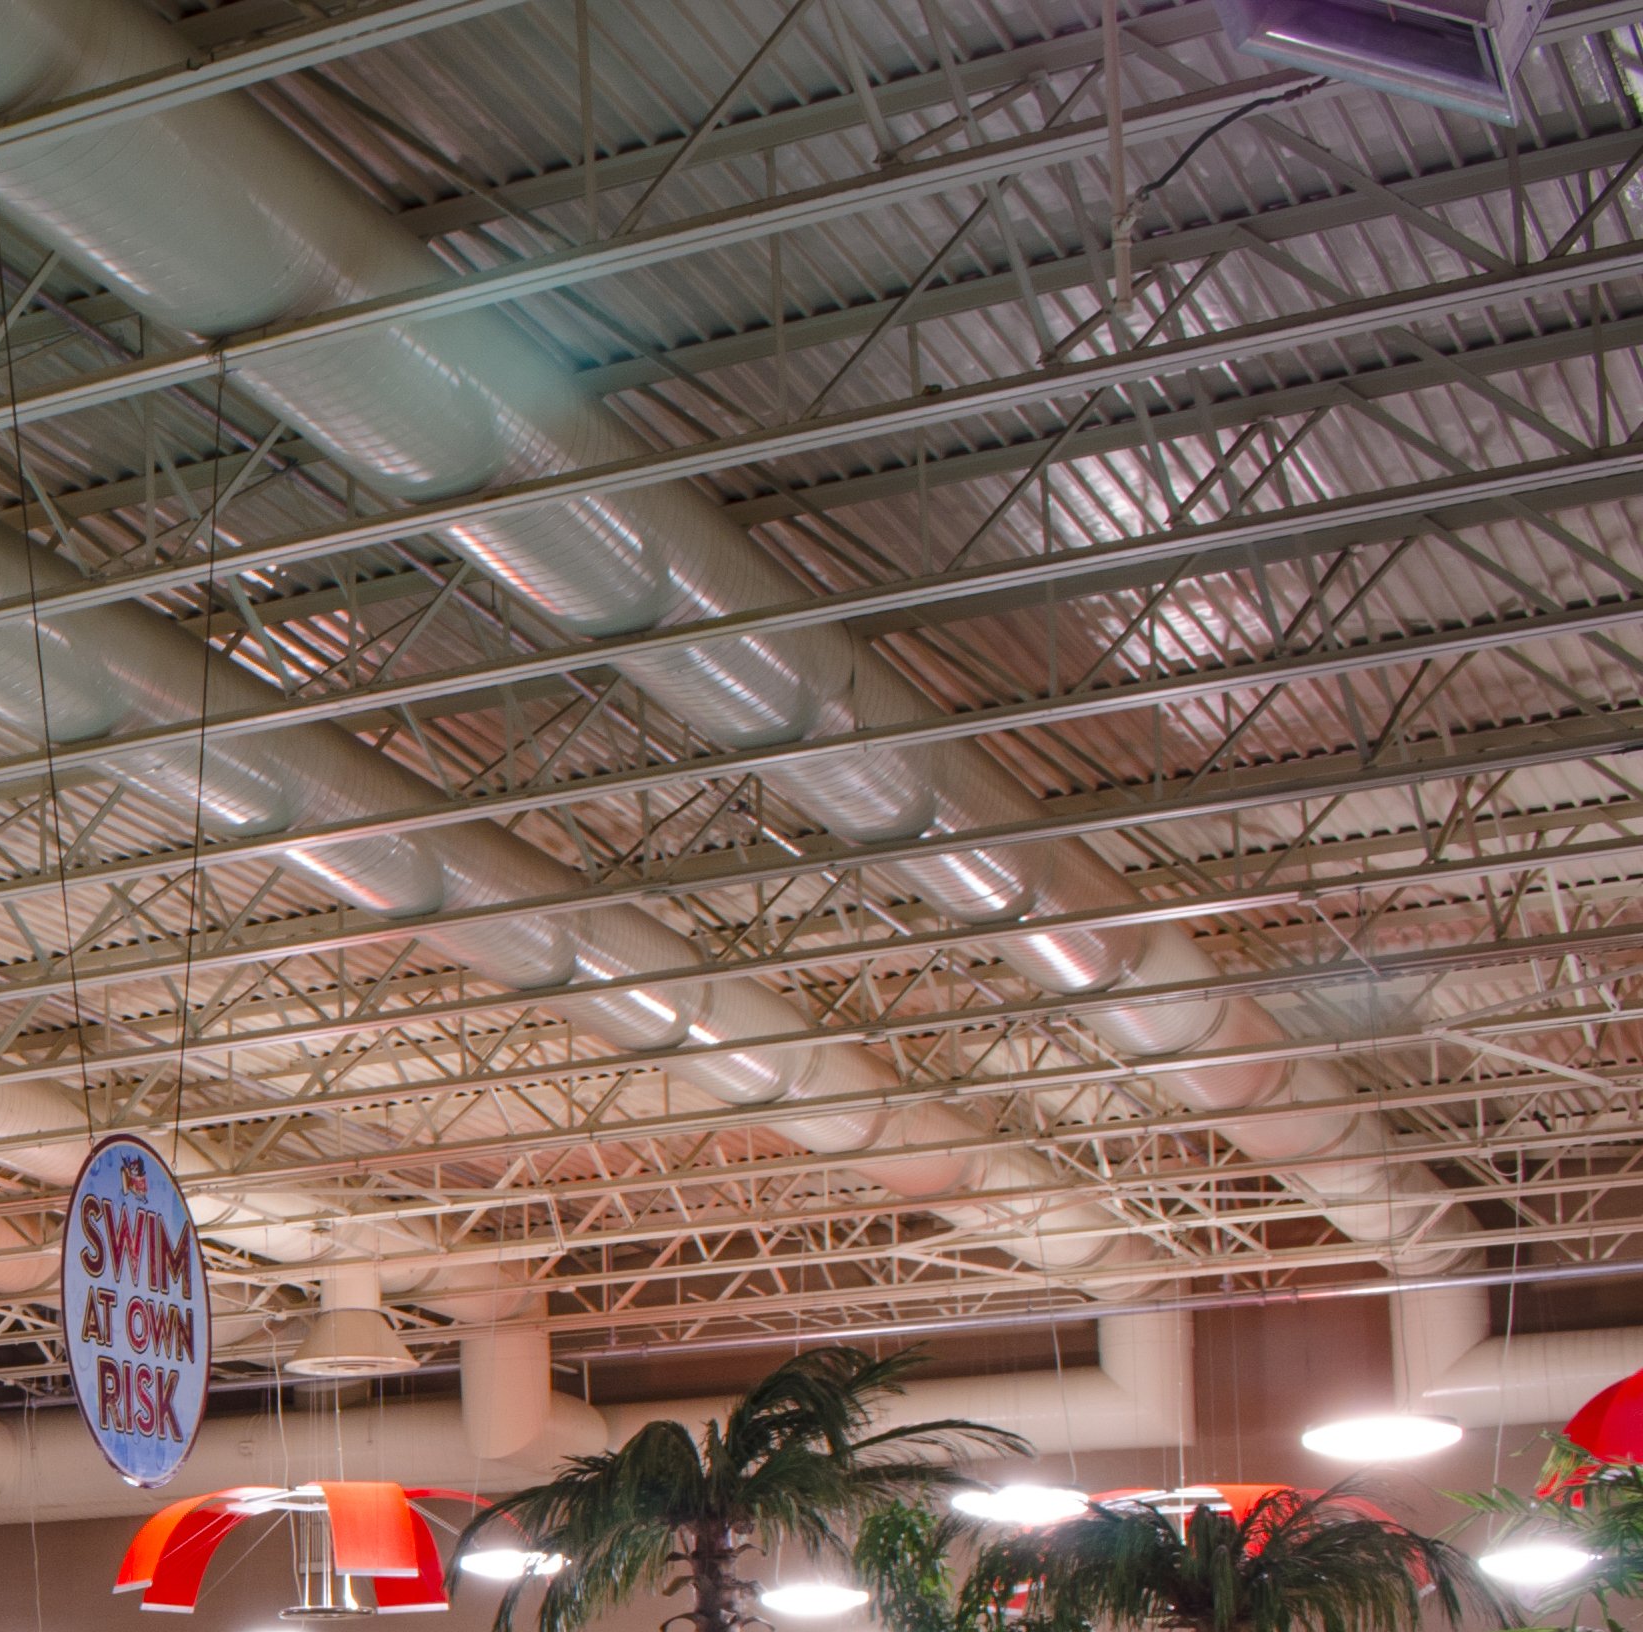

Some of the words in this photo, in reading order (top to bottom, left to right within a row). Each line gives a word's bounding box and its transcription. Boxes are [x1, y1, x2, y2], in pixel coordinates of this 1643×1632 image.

[80, 1193, 192, 1300] SWIM
[82, 1286, 117, 1347] AT
[125, 1297, 195, 1364] OWN
[97, 1356, 183, 1442] RISK
